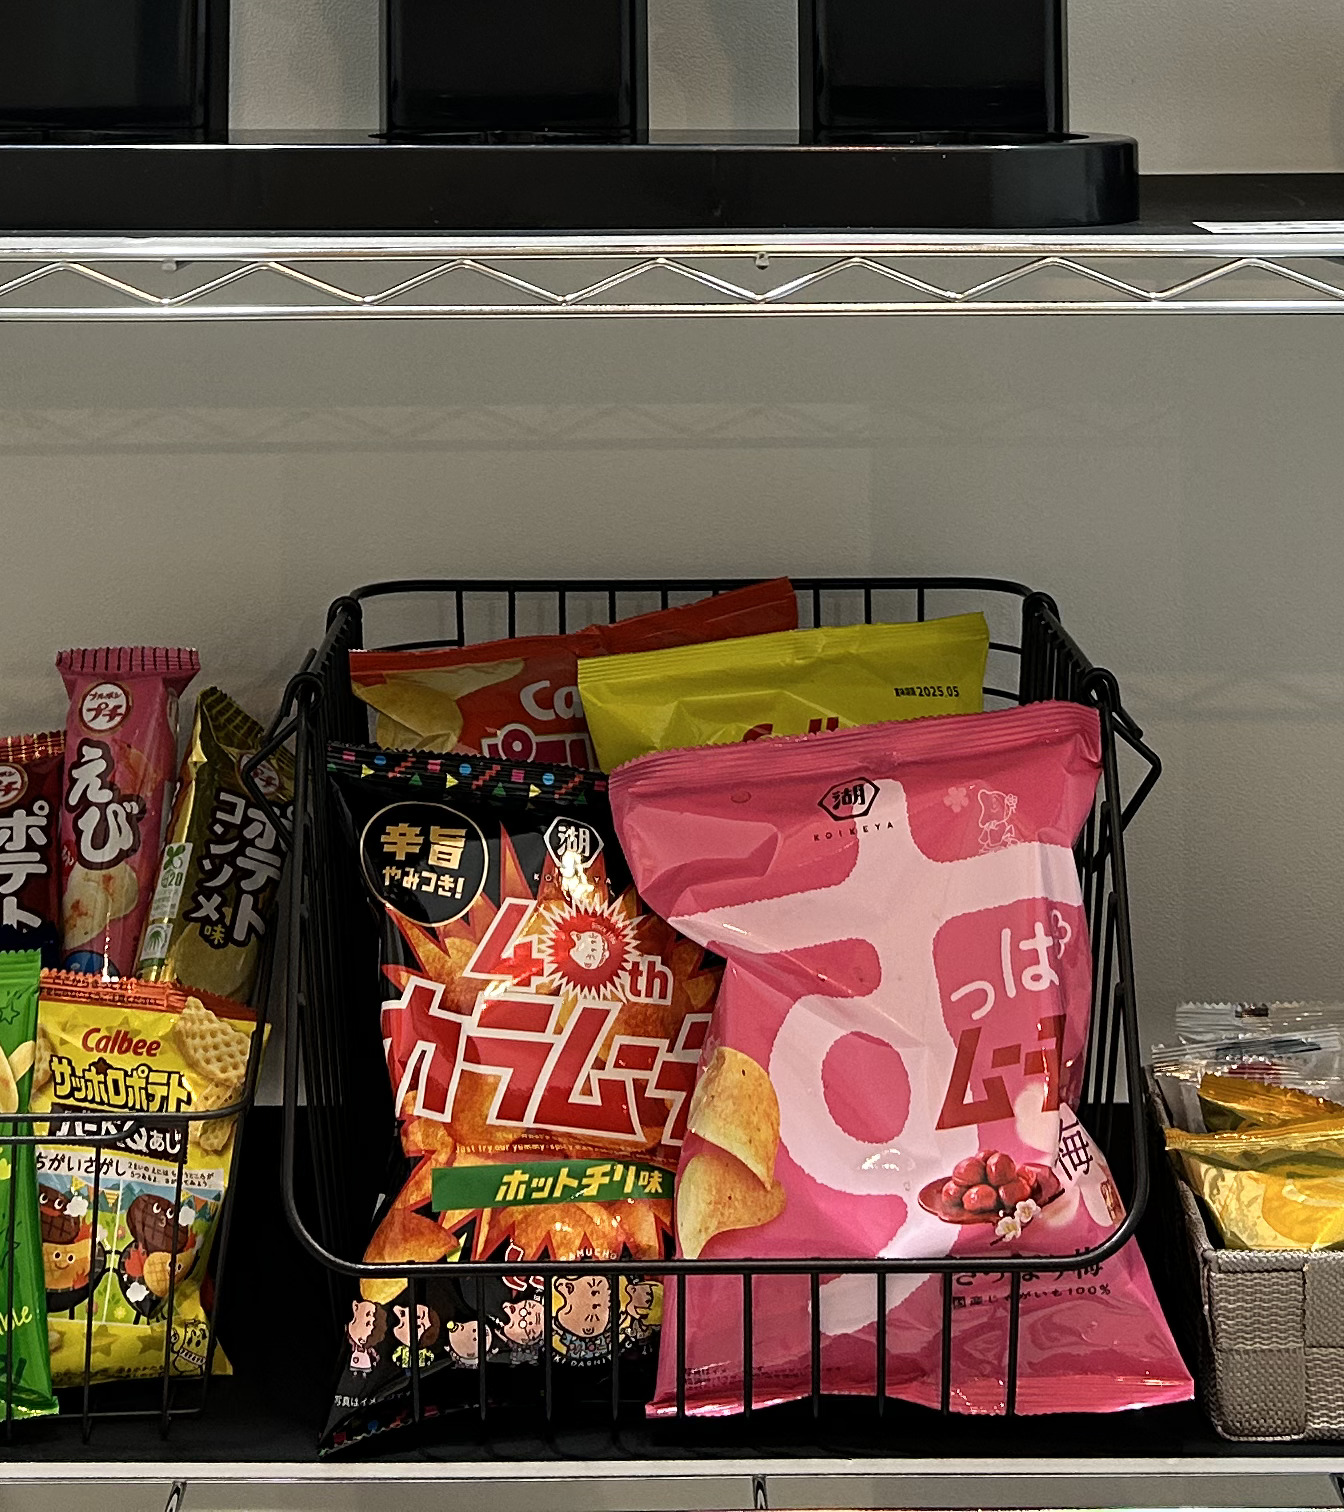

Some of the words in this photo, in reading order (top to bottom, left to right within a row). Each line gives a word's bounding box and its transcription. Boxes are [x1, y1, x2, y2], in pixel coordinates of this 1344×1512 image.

[85, 701, 124, 723] プチ
[88, 691, 123, 702] ブルボン
[67, 744, 139, 864] えび
[830, 783, 867, 811] 湖
[380, 822, 469, 870] 辛旨
[556, 824, 591, 857] 湖
[812, 821, 895, 842] KOIKEYA
[81, 1027, 162, 1058] Calbee
[50, 1054, 193, 1113] サッポロポテト
[494, 1163, 663, 1202] ホットチリ味
